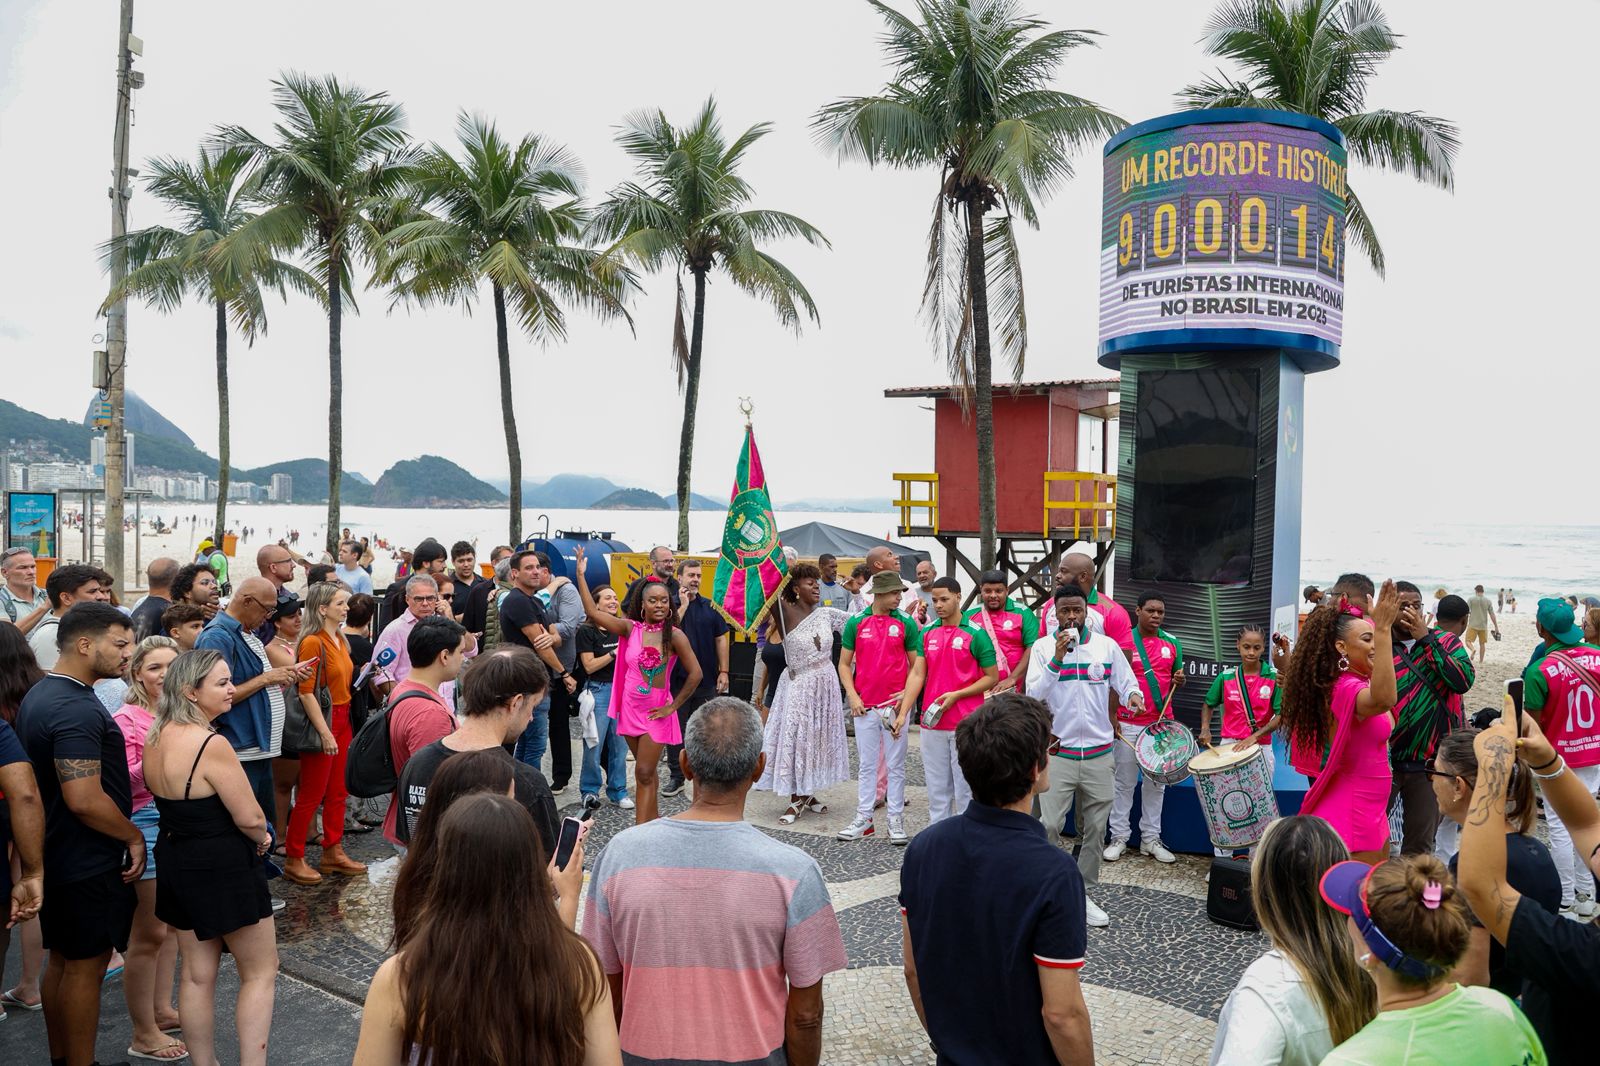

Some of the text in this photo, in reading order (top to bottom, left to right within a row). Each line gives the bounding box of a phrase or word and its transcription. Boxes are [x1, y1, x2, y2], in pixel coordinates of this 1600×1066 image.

[1121, 153, 1148, 193] UM
[1153, 142, 1271, 184] RECORDE
[1119, 197, 1344, 275] 9.000.14
[1122, 283, 1139, 301] DE
[1141, 275, 1232, 297] TURISTAS
[1160, 298, 1327, 325] NO BRASIL EM 2025
[1566, 684, 1595, 732] 10
[409, 785, 426, 796] BLAZE
[1222, 886, 1238, 901] JBL
